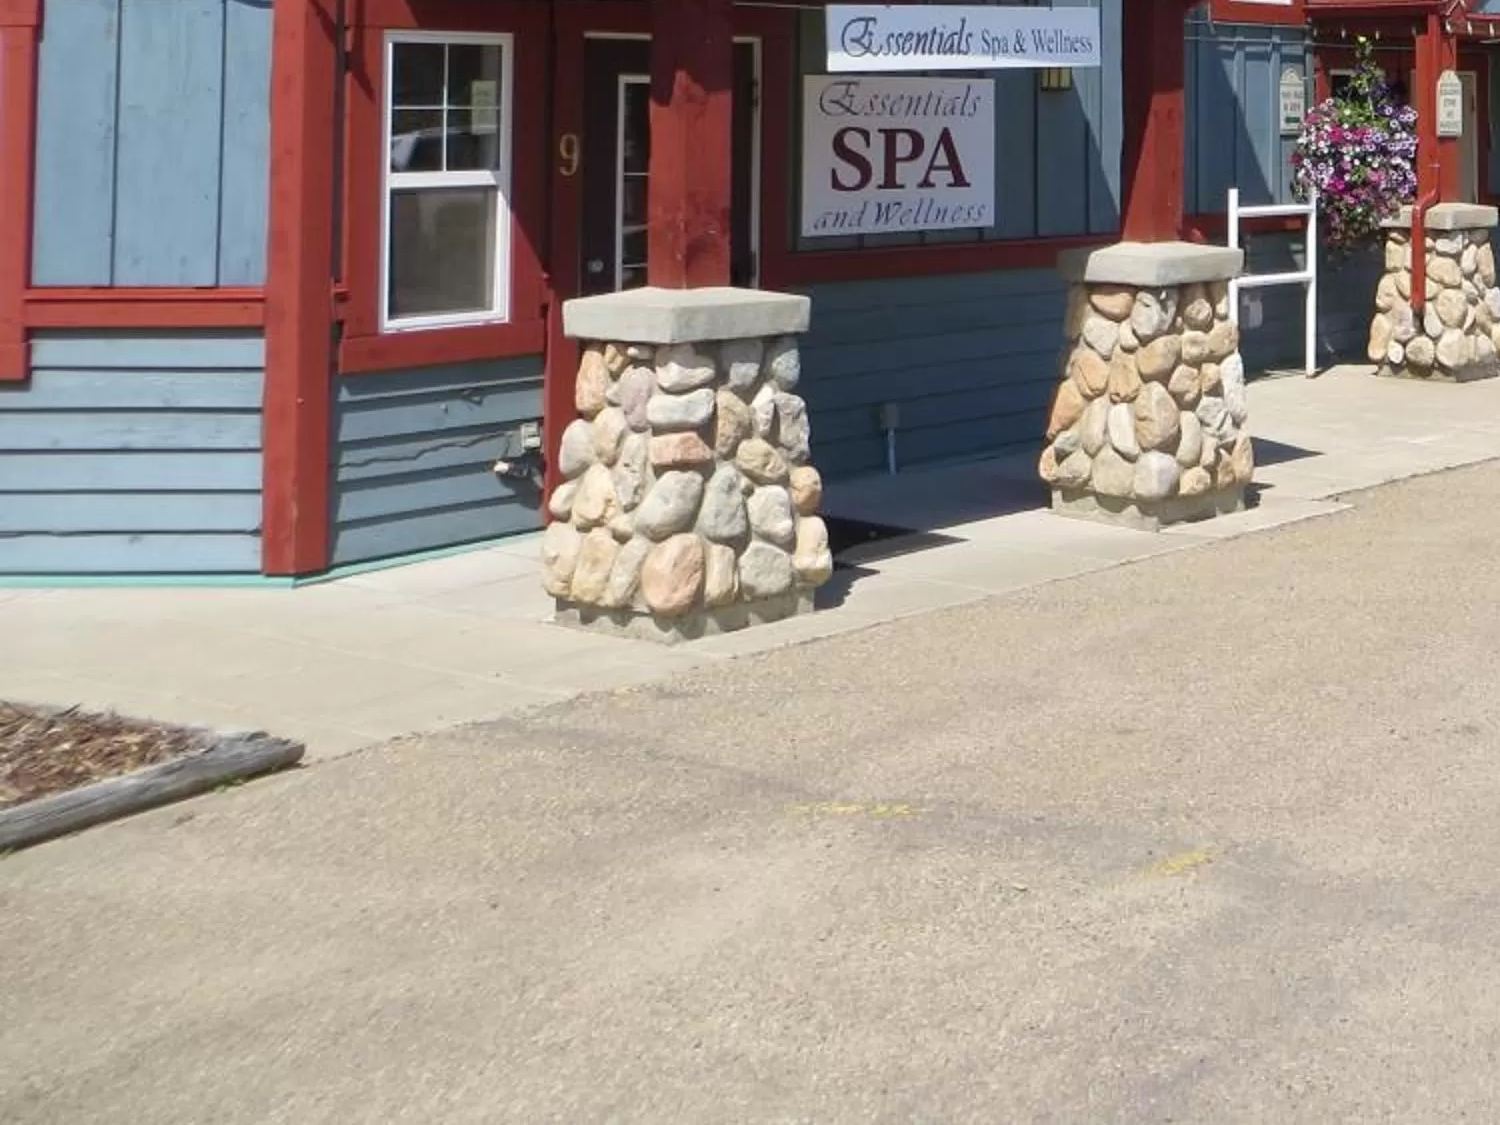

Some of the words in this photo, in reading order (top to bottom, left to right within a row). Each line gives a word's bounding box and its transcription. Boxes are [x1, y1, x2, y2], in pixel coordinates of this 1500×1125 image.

[841, 16, 974, 58] Essentials
[981, 28, 1009, 61] Spa
[1013, 28, 1026, 54] &
[1031, 28, 1094, 54] Wellness
[819, 80, 981, 118] Essentials
[560, 133, 580, 176] 9
[831, 126, 972, 192] SPA
[813, 200, 869, 230] and
[875, 197, 987, 227] Wellness
